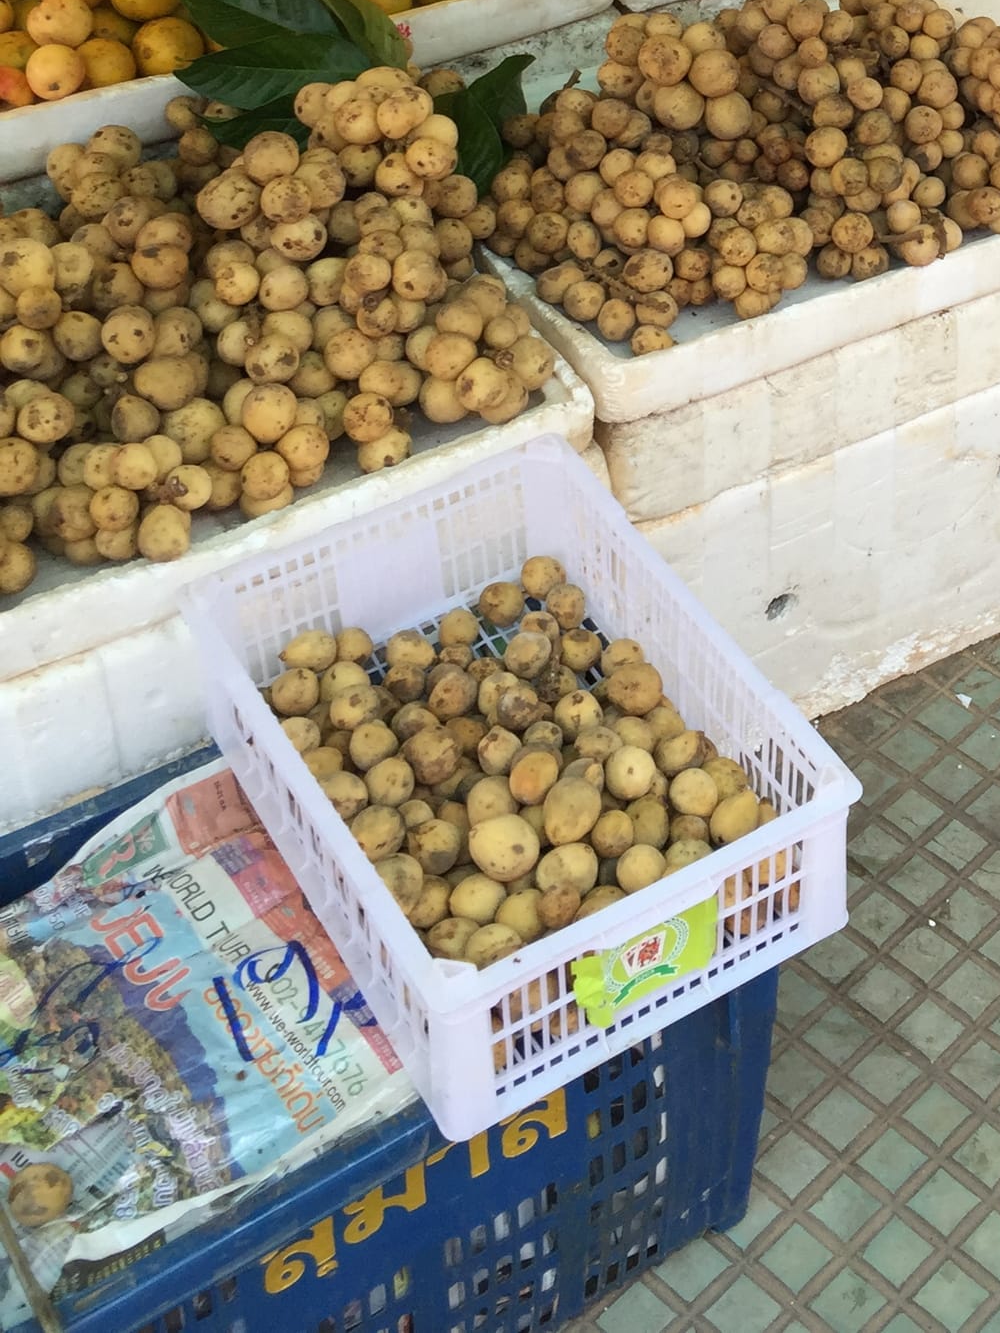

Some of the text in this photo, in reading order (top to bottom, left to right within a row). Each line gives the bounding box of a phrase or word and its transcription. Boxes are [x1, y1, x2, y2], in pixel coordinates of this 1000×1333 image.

[89, 905, 193, 1012] JEJU
[166, 865, 217, 923] ORLD
[206, 920, 252, 964] TUR
